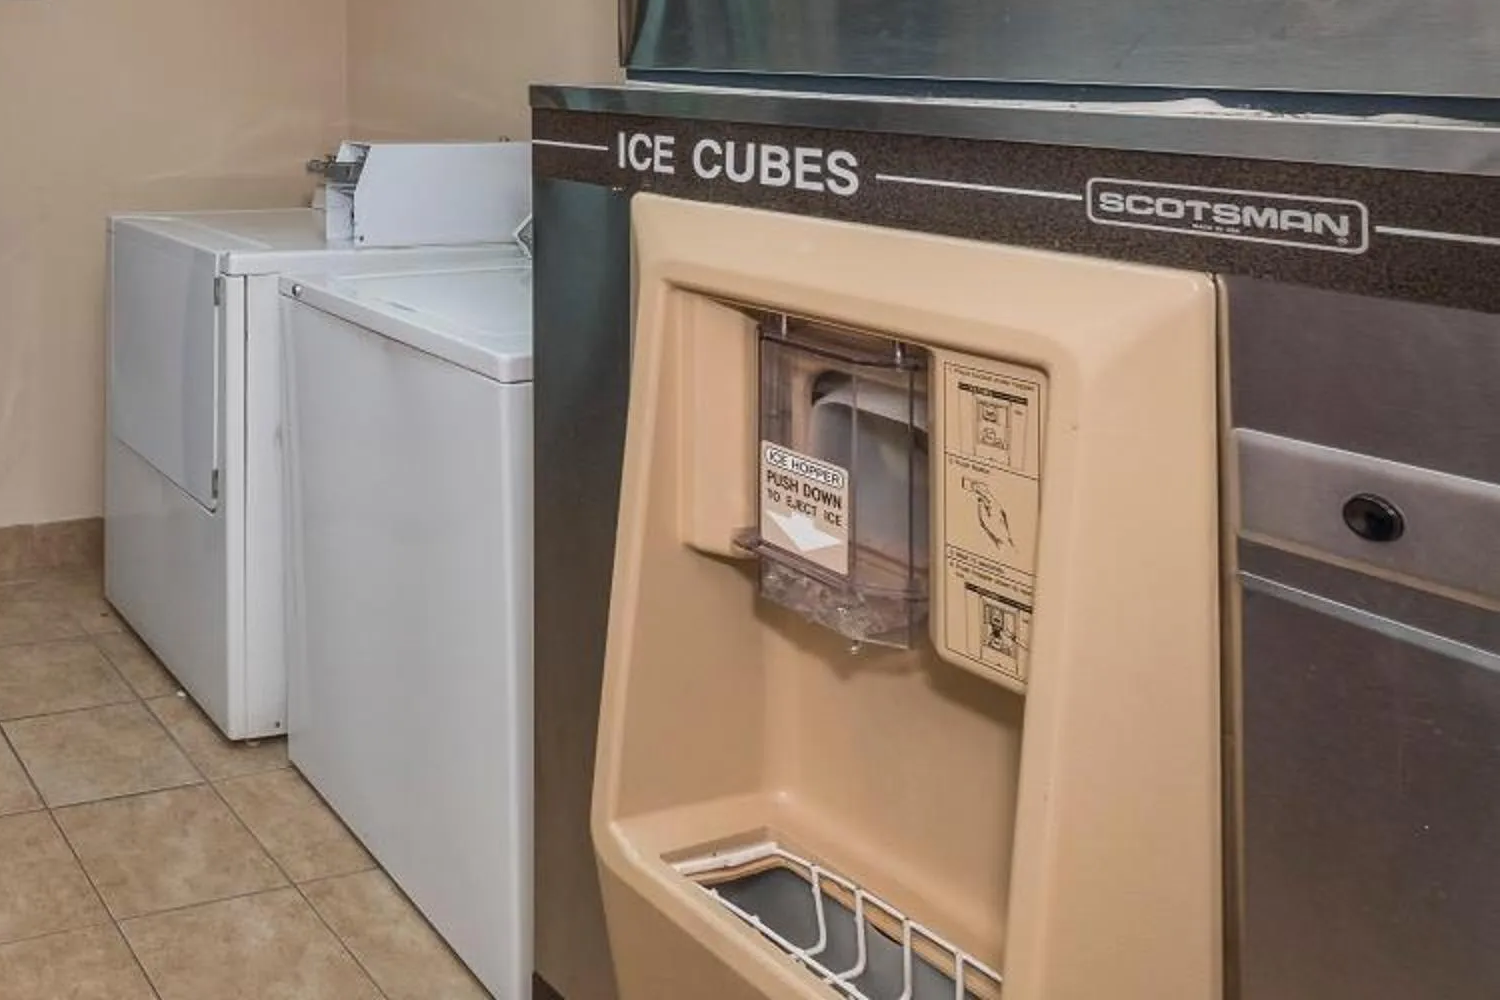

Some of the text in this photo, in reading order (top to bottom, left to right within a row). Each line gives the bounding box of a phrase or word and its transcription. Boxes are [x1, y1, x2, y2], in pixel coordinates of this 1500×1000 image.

[617, 131, 860, 196] ICE CUBES
[1099, 191, 1349, 237] SCOTSMAN
[767, 469, 842, 510] PUSH DOWN
[791, 458, 841, 485] HOPPER
[767, 487, 842, 527] TO EJECT ICE
